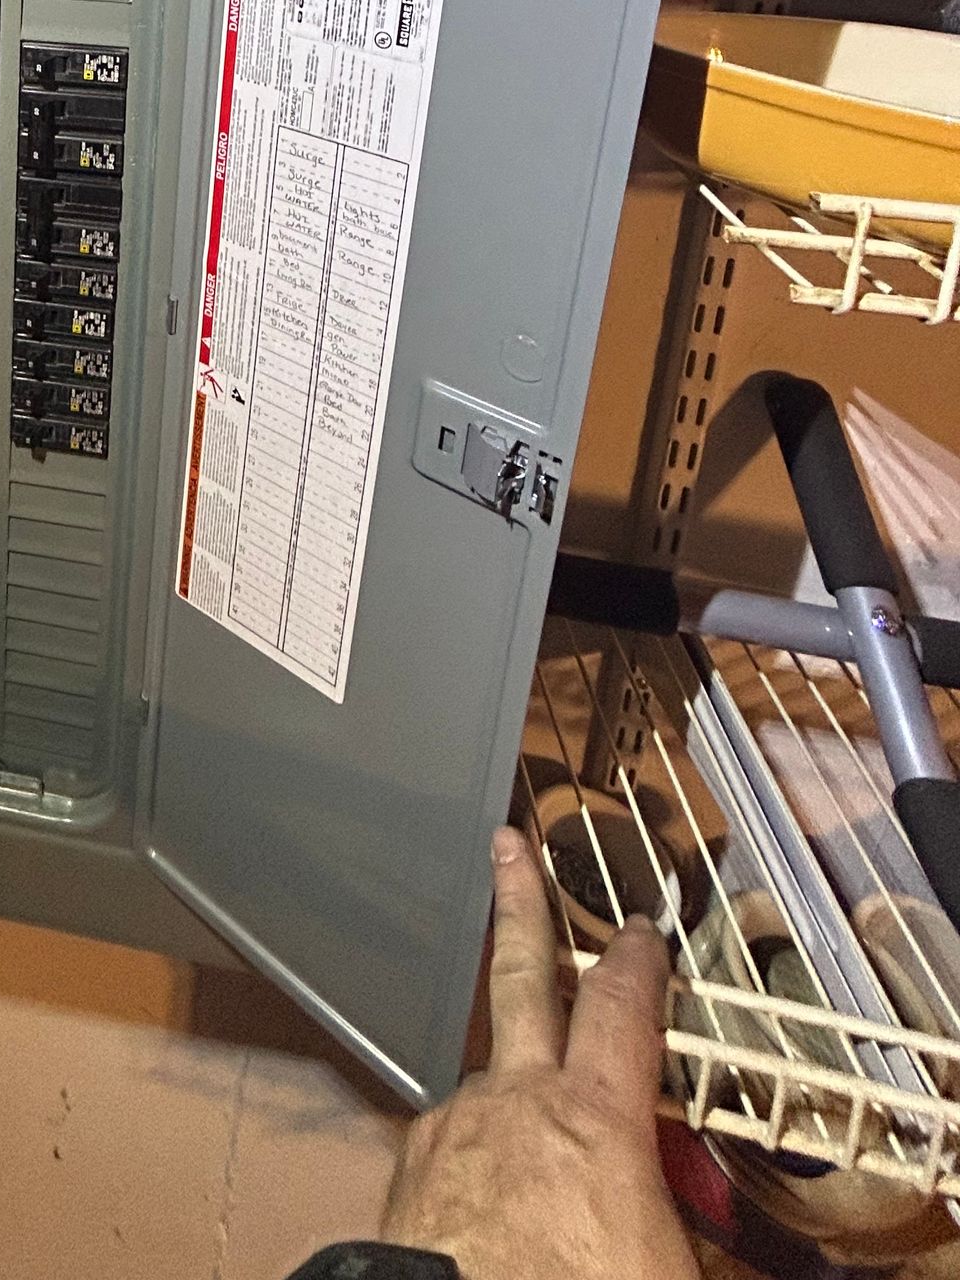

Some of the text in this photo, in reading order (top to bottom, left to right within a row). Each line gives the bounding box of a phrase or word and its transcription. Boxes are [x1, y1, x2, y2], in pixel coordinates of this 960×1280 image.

[398, 4, 413, 47] SQUARE
[216, 132, 228, 180] PELIGRO
[290, 143, 325, 168] Surge
[340, 224, 374, 248] Range
[338, 250, 376, 276] Range
[205, 273, 216, 318] DANGER
